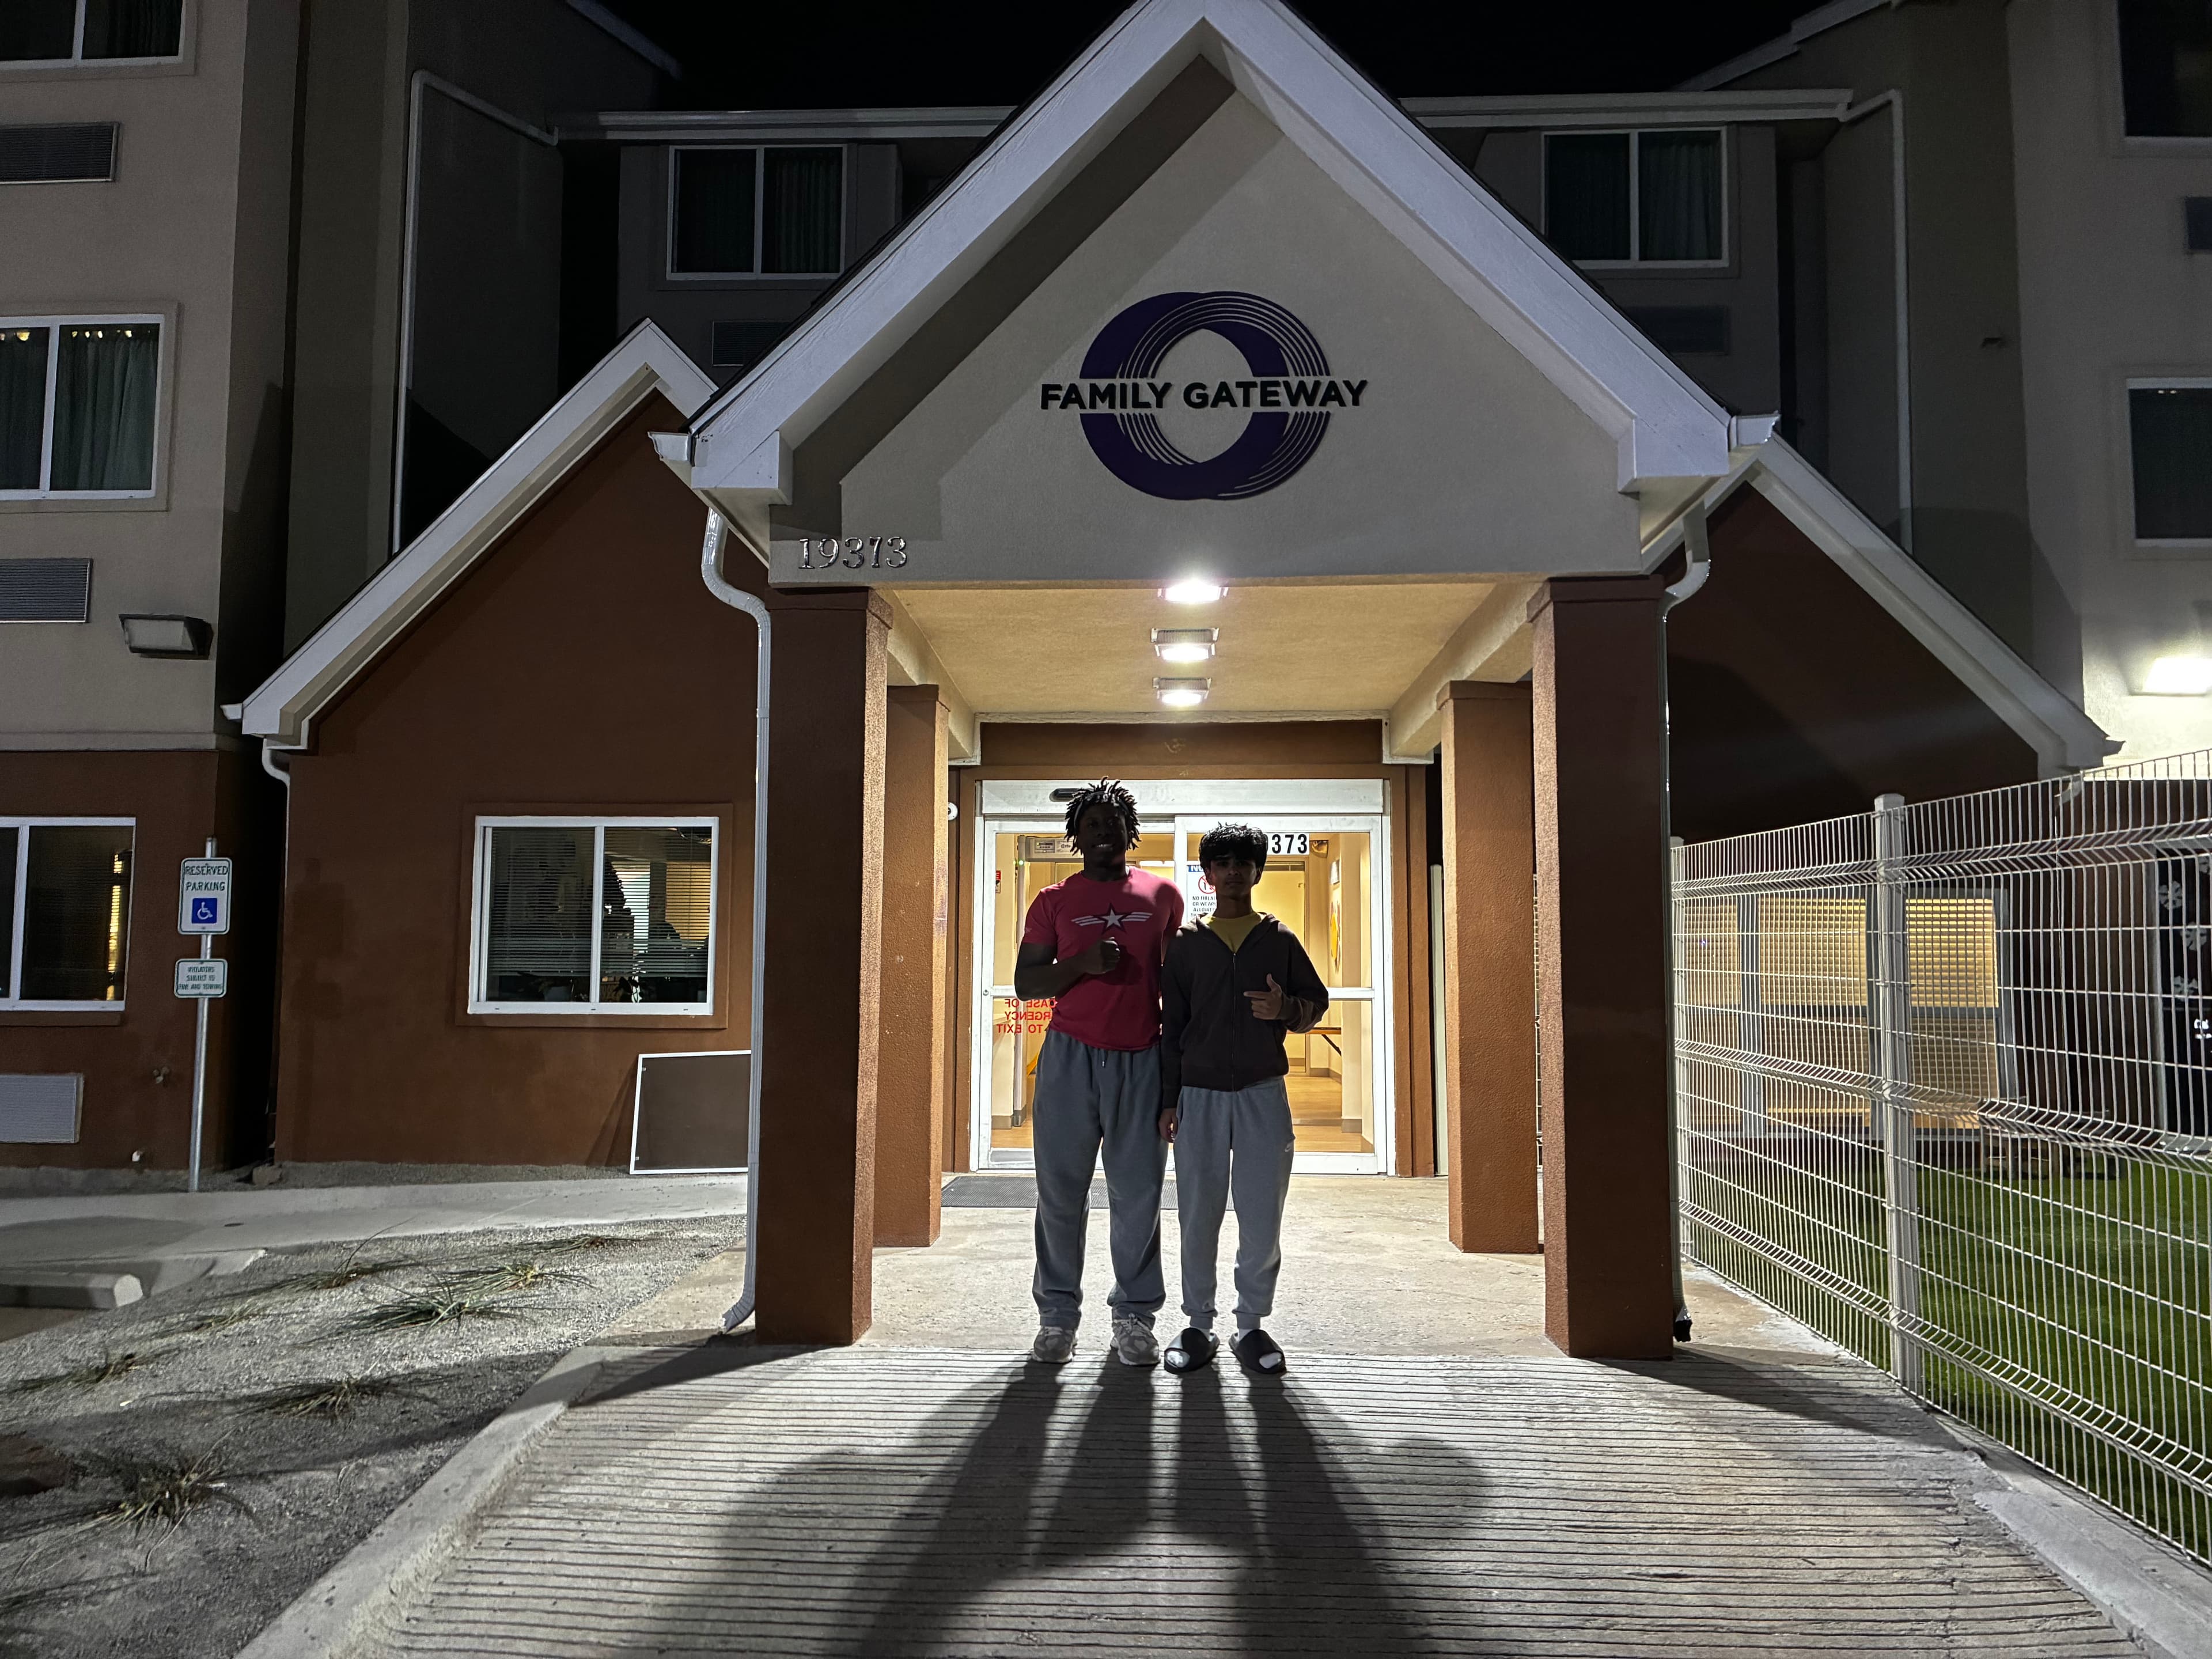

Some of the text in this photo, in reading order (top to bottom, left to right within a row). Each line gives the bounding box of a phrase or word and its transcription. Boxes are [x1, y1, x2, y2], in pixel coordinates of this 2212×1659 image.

[1040, 380, 1368, 410] FAMILY GATEWAY
[798, 536, 907, 569] 19373
[1271, 834, 1307, 854] 373
[184, 866, 228, 875] RESERVED
[185, 881, 225, 891] PARKING
